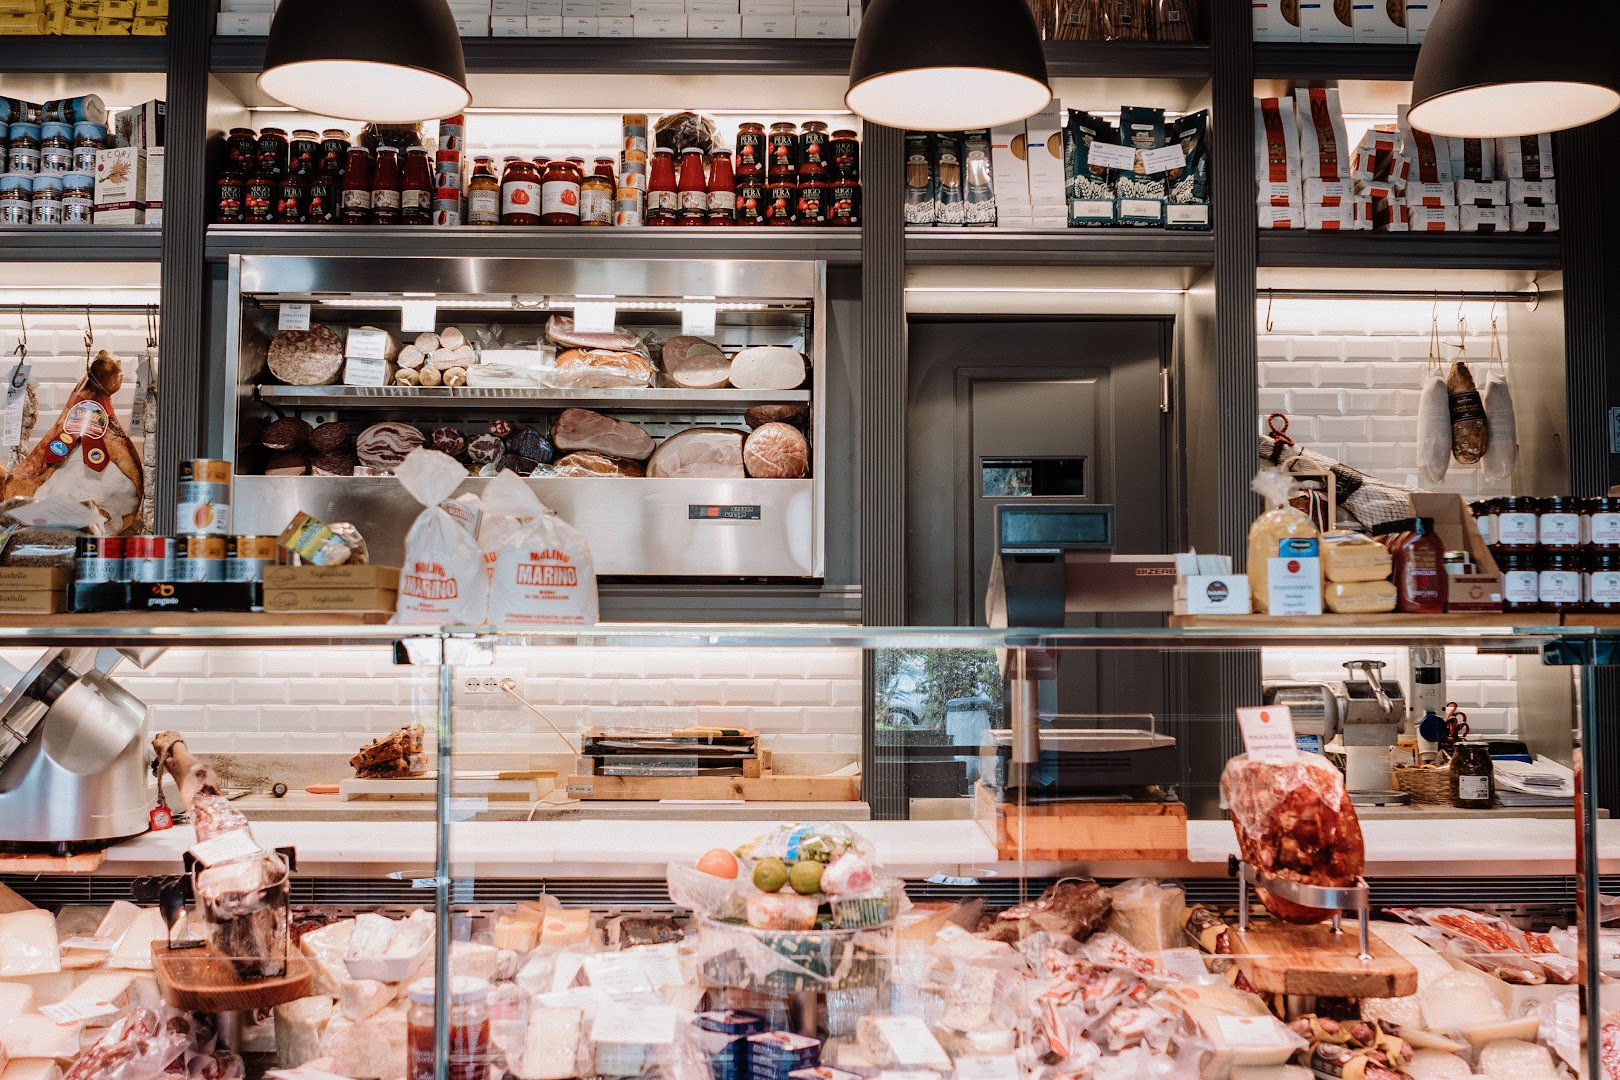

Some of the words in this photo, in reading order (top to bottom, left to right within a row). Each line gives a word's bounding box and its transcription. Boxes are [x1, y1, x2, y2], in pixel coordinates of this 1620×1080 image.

[741, 135, 758, 143] PERA
[774, 136, 791, 145] PERA
[806, 134, 823, 142] PERA
[284, 187, 302, 196] PERA
[743, 188, 760, 197] PERA
[773, 188, 790, 197] PERA
[518, 565, 577, 586] MARINO
[404, 576, 457, 599] MARINO
